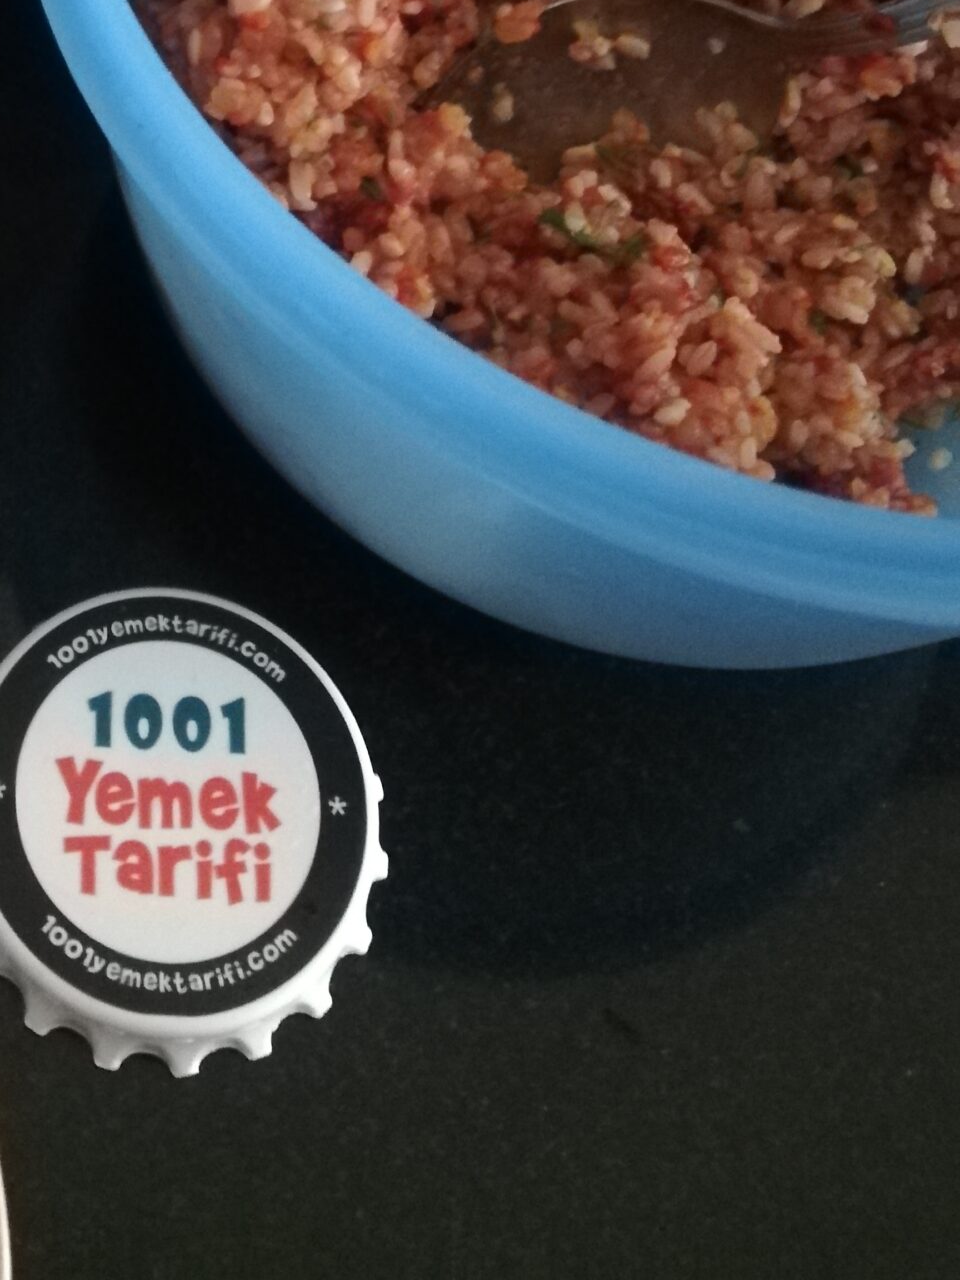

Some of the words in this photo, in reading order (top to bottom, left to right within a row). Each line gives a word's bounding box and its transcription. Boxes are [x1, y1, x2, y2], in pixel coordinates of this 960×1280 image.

[46, 613, 288, 684] 1001yemektarifi.com
[87, 690, 247, 755] 1001
[54, 755, 282, 834] Yemek
[63, 834, 272, 906] Tarifi
[40, 914, 299, 994] 1001yemektarifi.com
